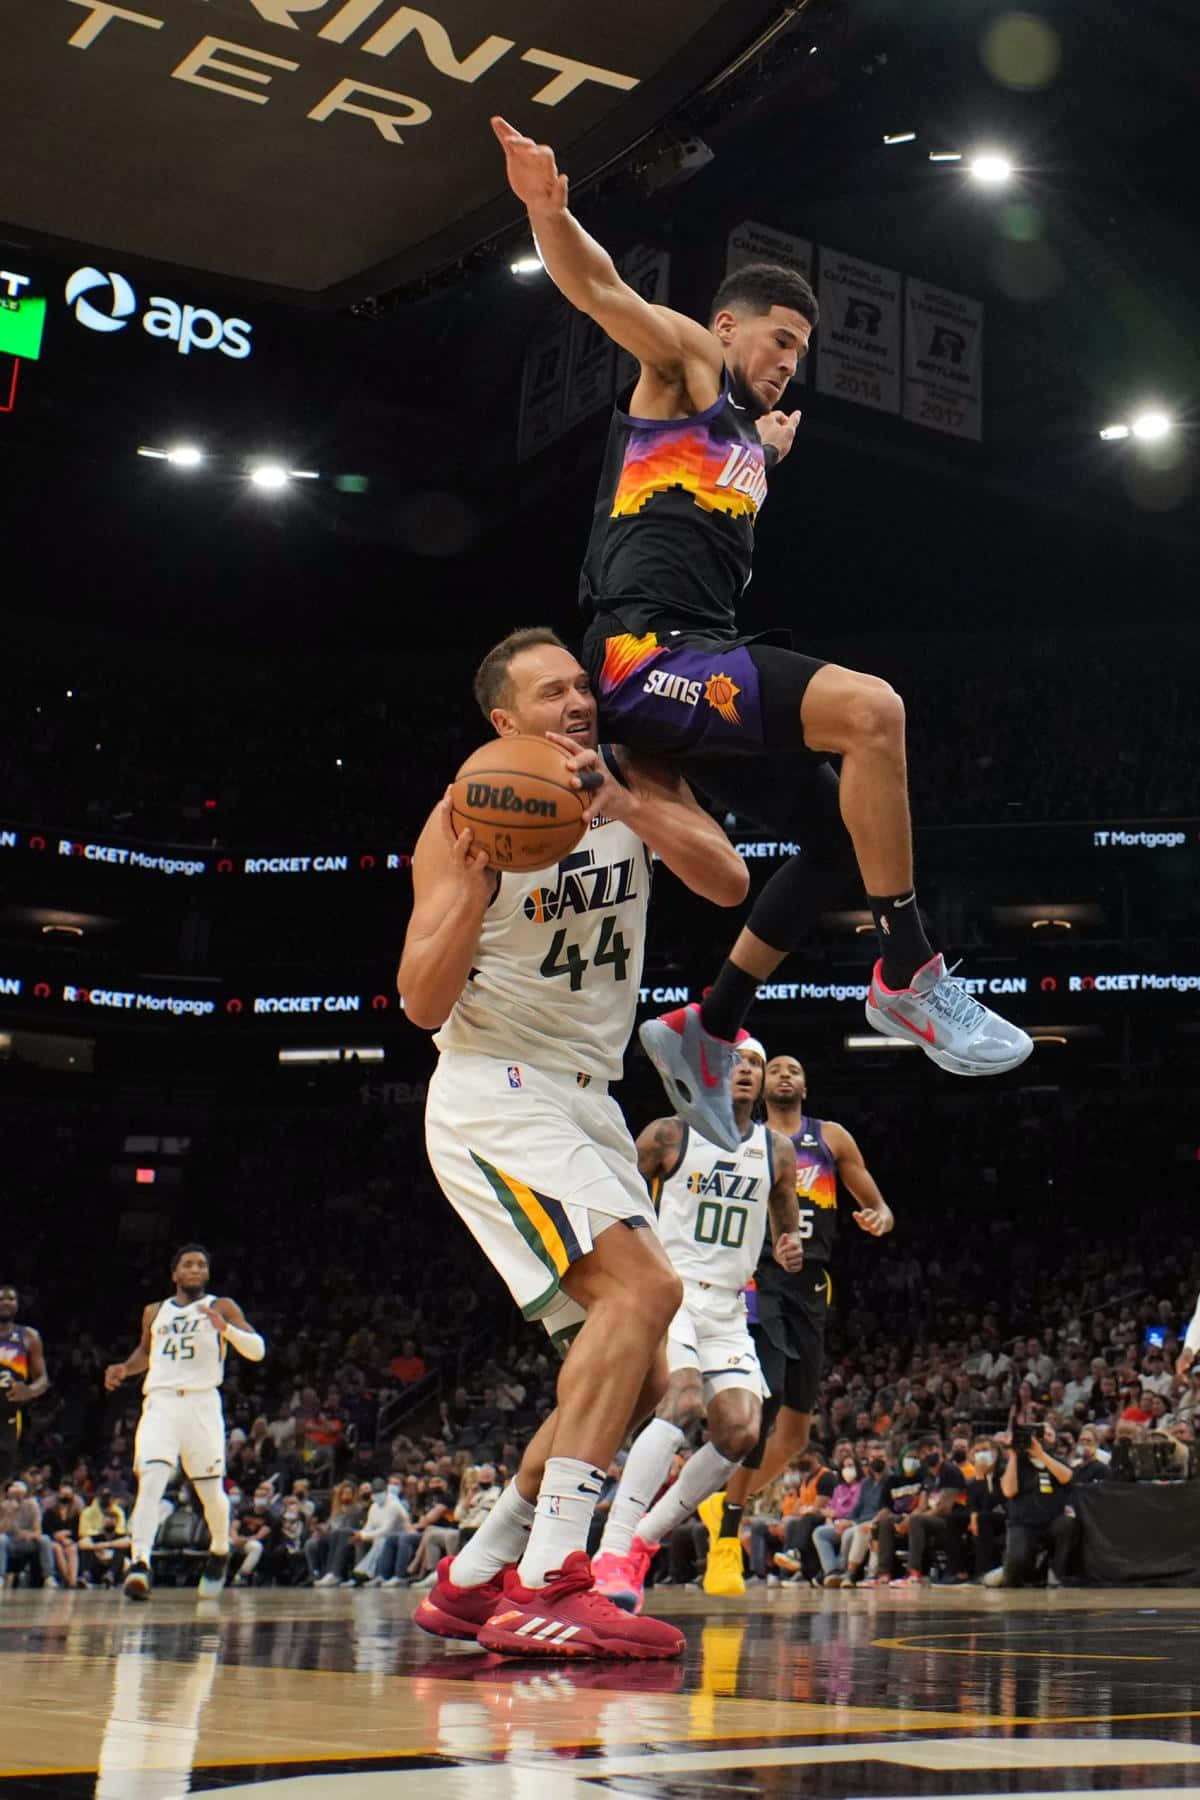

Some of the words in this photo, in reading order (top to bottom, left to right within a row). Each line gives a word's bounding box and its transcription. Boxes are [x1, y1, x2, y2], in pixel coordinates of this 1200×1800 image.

[143, 297, 252, 359] aps
[643, 670, 702, 706] SUNS
[466, 783, 558, 818] Wilson
[1111, 831, 1186, 848] Mortgage
[58, 840, 128, 864] ROCKET
[130, 851, 205, 876] Mortgage
[244, 857, 310, 873] ROCKET
[313, 856, 348, 871] CAN
[539, 915, 631, 992] 44
[652, 987, 689, 1002] CAN
[989, 978, 1027, 993] CAN
[1069, 975, 1140, 991] ROCKET
[63, 985, 135, 1008] ROCKET
[136, 994, 215, 1016] Mortgage
[254, 997, 321, 1013] ROCKET
[324, 996, 360, 1011] CAN
[687, 1160, 763, 1203] JAZZ
[694, 1201, 748, 1249] 00
[162, 1336, 194, 1361] 45
